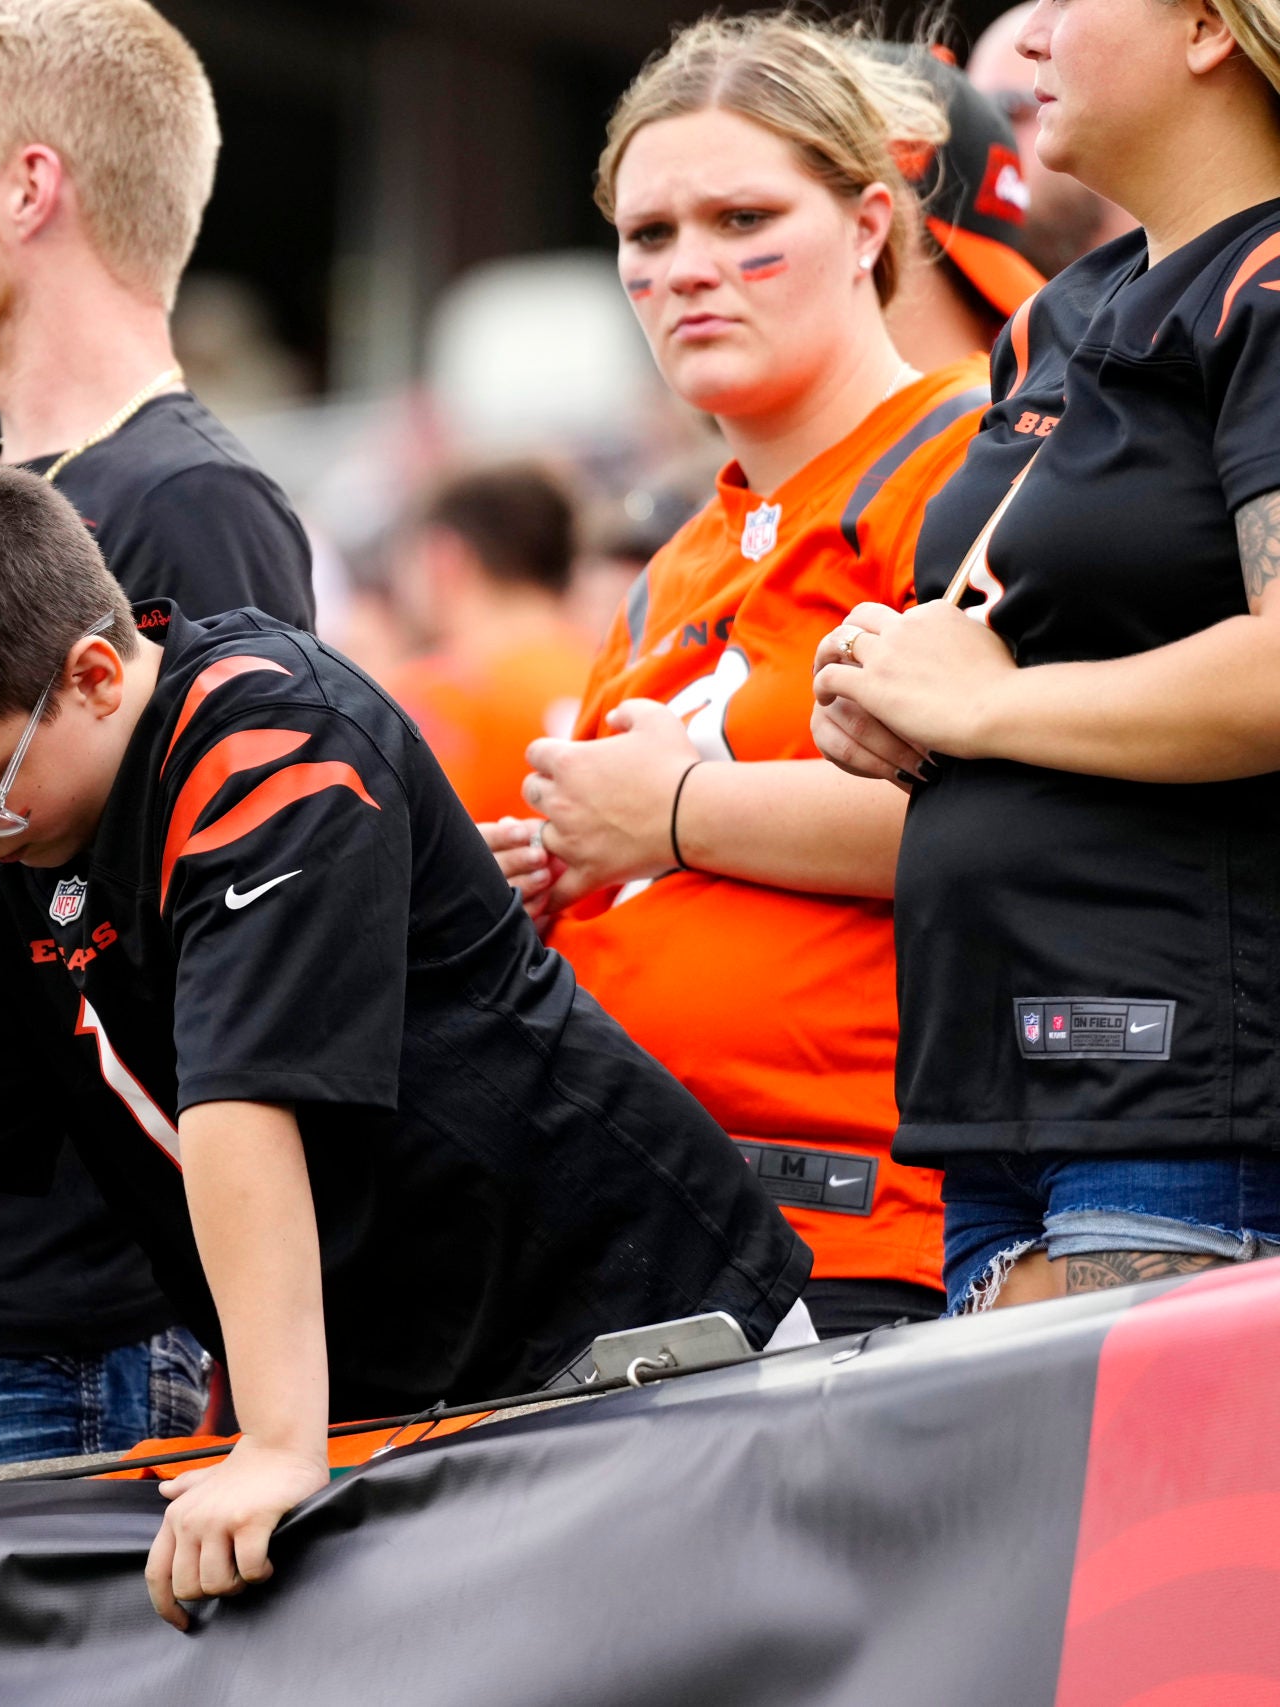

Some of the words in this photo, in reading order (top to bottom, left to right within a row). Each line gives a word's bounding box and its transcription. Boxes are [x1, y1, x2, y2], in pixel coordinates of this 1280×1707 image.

[746, 525, 769, 550] NFL
[55, 896, 77, 916] NFL
[1074, 1017, 1087, 1028] ON
[1089, 1017, 1123, 1028] FIELD
[781, 1155, 806, 1177] M
